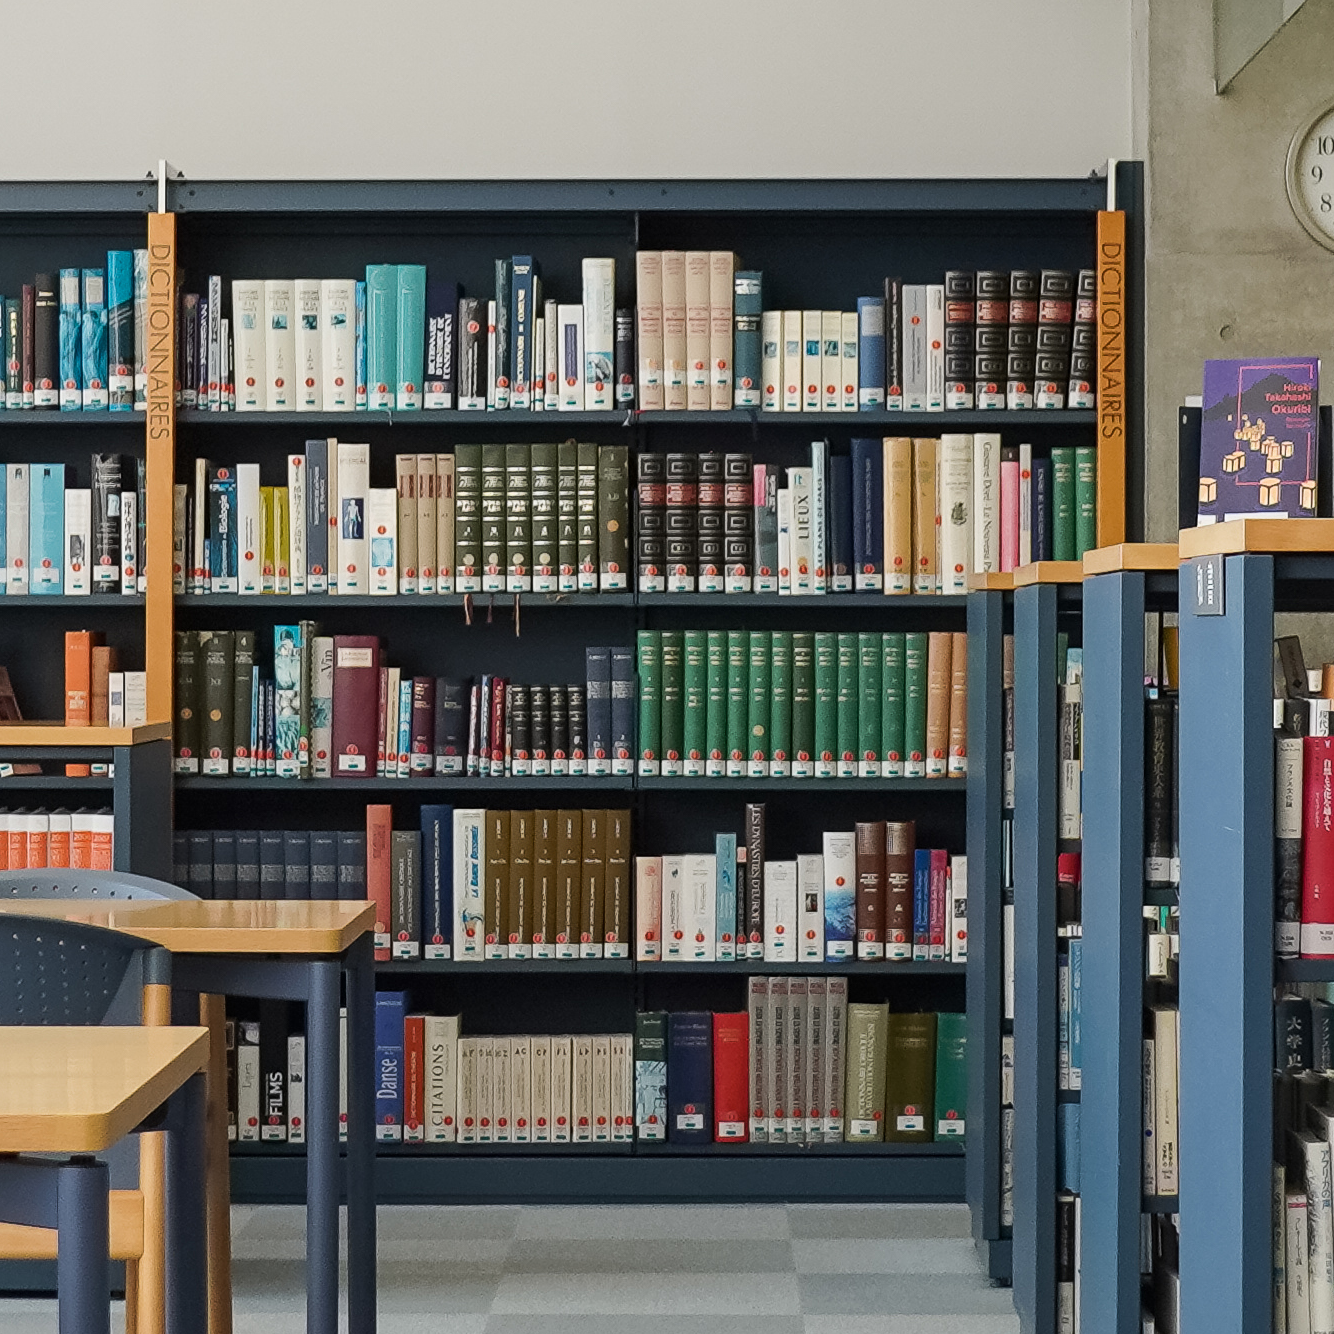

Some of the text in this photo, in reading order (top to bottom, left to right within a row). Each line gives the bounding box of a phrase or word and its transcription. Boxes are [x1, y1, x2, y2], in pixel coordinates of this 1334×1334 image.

[1311, 166, 1323, 184] 9
[1320, 193, 1332, 212] 8
[150, 244, 171, 440] DICTIONNAIRES
[1101, 242, 1123, 440] DICTIONNAIRES
[1265, 392, 1311, 401] Takahashi
[1283, 383, 1311, 391] Hiroki
[1271, 404, 1311, 414] Okuribi
[798, 496, 809, 540] LIEUX
[817, 507, 823, 519] DE
[320, 650, 332, 674] Vin
[752, 806, 761, 824] LES
[751, 826, 761, 878] DYNASTIES
[376, 1058, 398, 1100] Danse
[432, 1044, 444, 1127] CITATIONS
[269, 1072, 283, 1117] FILMS
